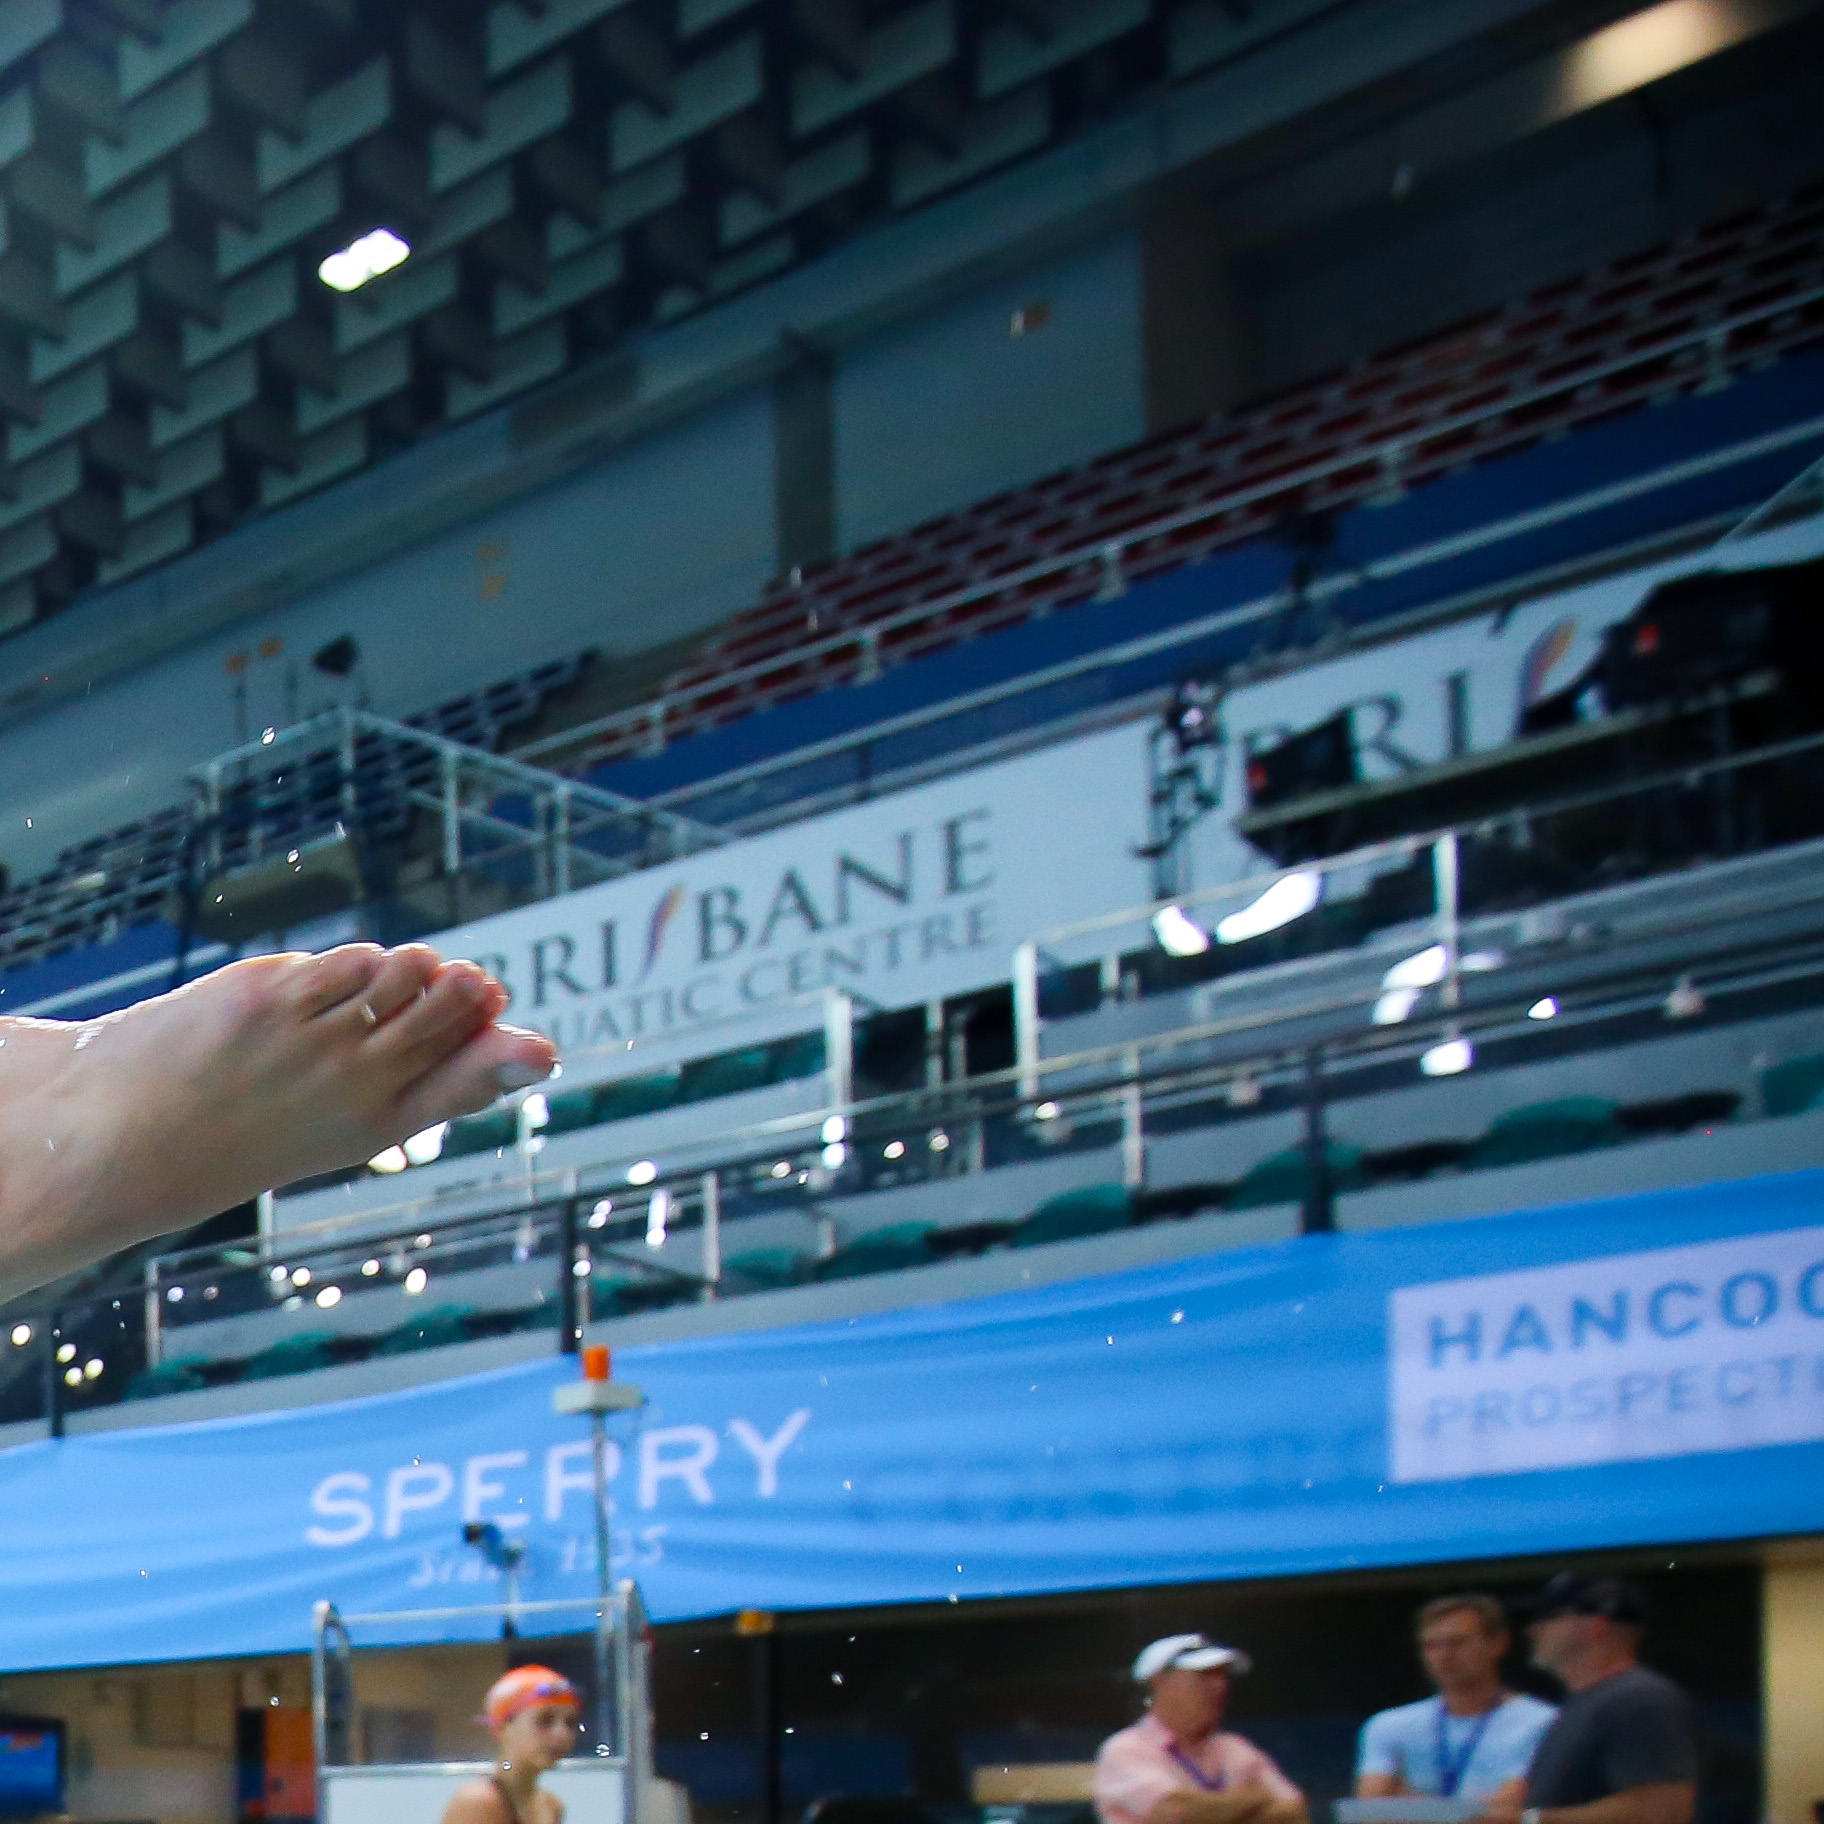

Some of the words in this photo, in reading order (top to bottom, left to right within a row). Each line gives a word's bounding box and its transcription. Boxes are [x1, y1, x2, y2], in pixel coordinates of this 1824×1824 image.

[534, 980, 713, 1050] UATIC
[739, 905, 996, 1002] CENTRE
[304, 1407, 811, 1547] SPERRY
[406, 1546, 530, 1588] Sin
